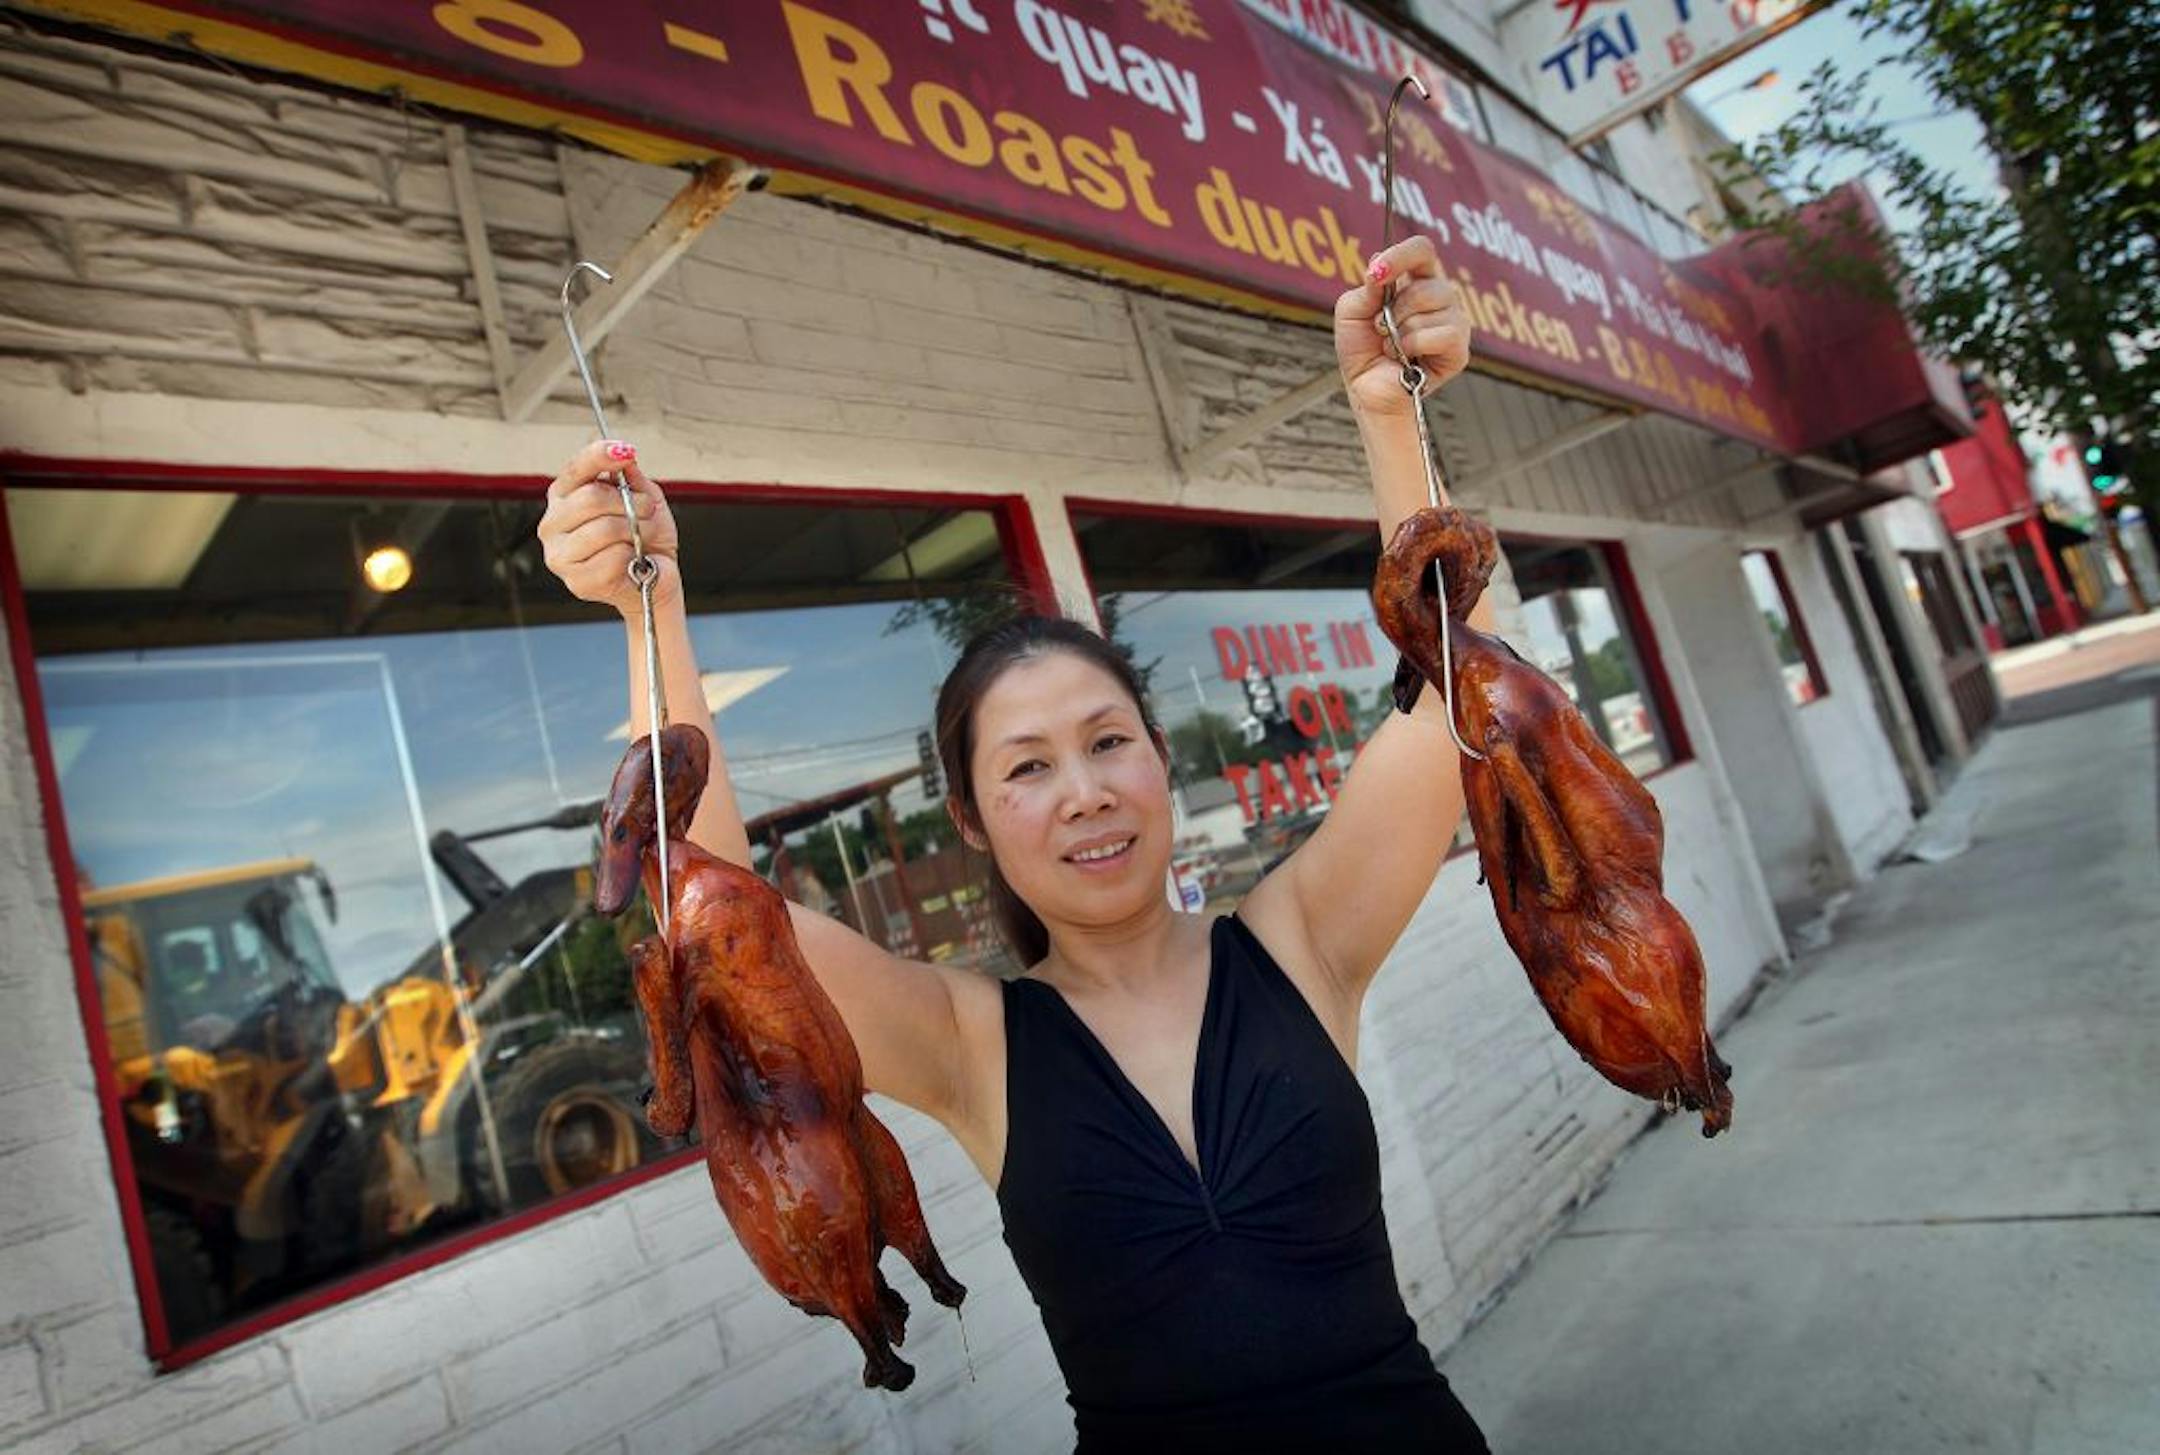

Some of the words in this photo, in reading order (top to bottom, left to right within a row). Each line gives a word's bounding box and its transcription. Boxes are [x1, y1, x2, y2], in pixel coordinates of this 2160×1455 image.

[1013, 0, 1205, 142] quay
[1540, 11, 1639, 92] TAI
[780, 0, 1172, 228] Roast
[1212, 622, 1326, 682] DINE
[1330, 622, 1376, 668] IN
[1287, 683, 1352, 737] OR
[1222, 748, 1341, 823] TAKE
